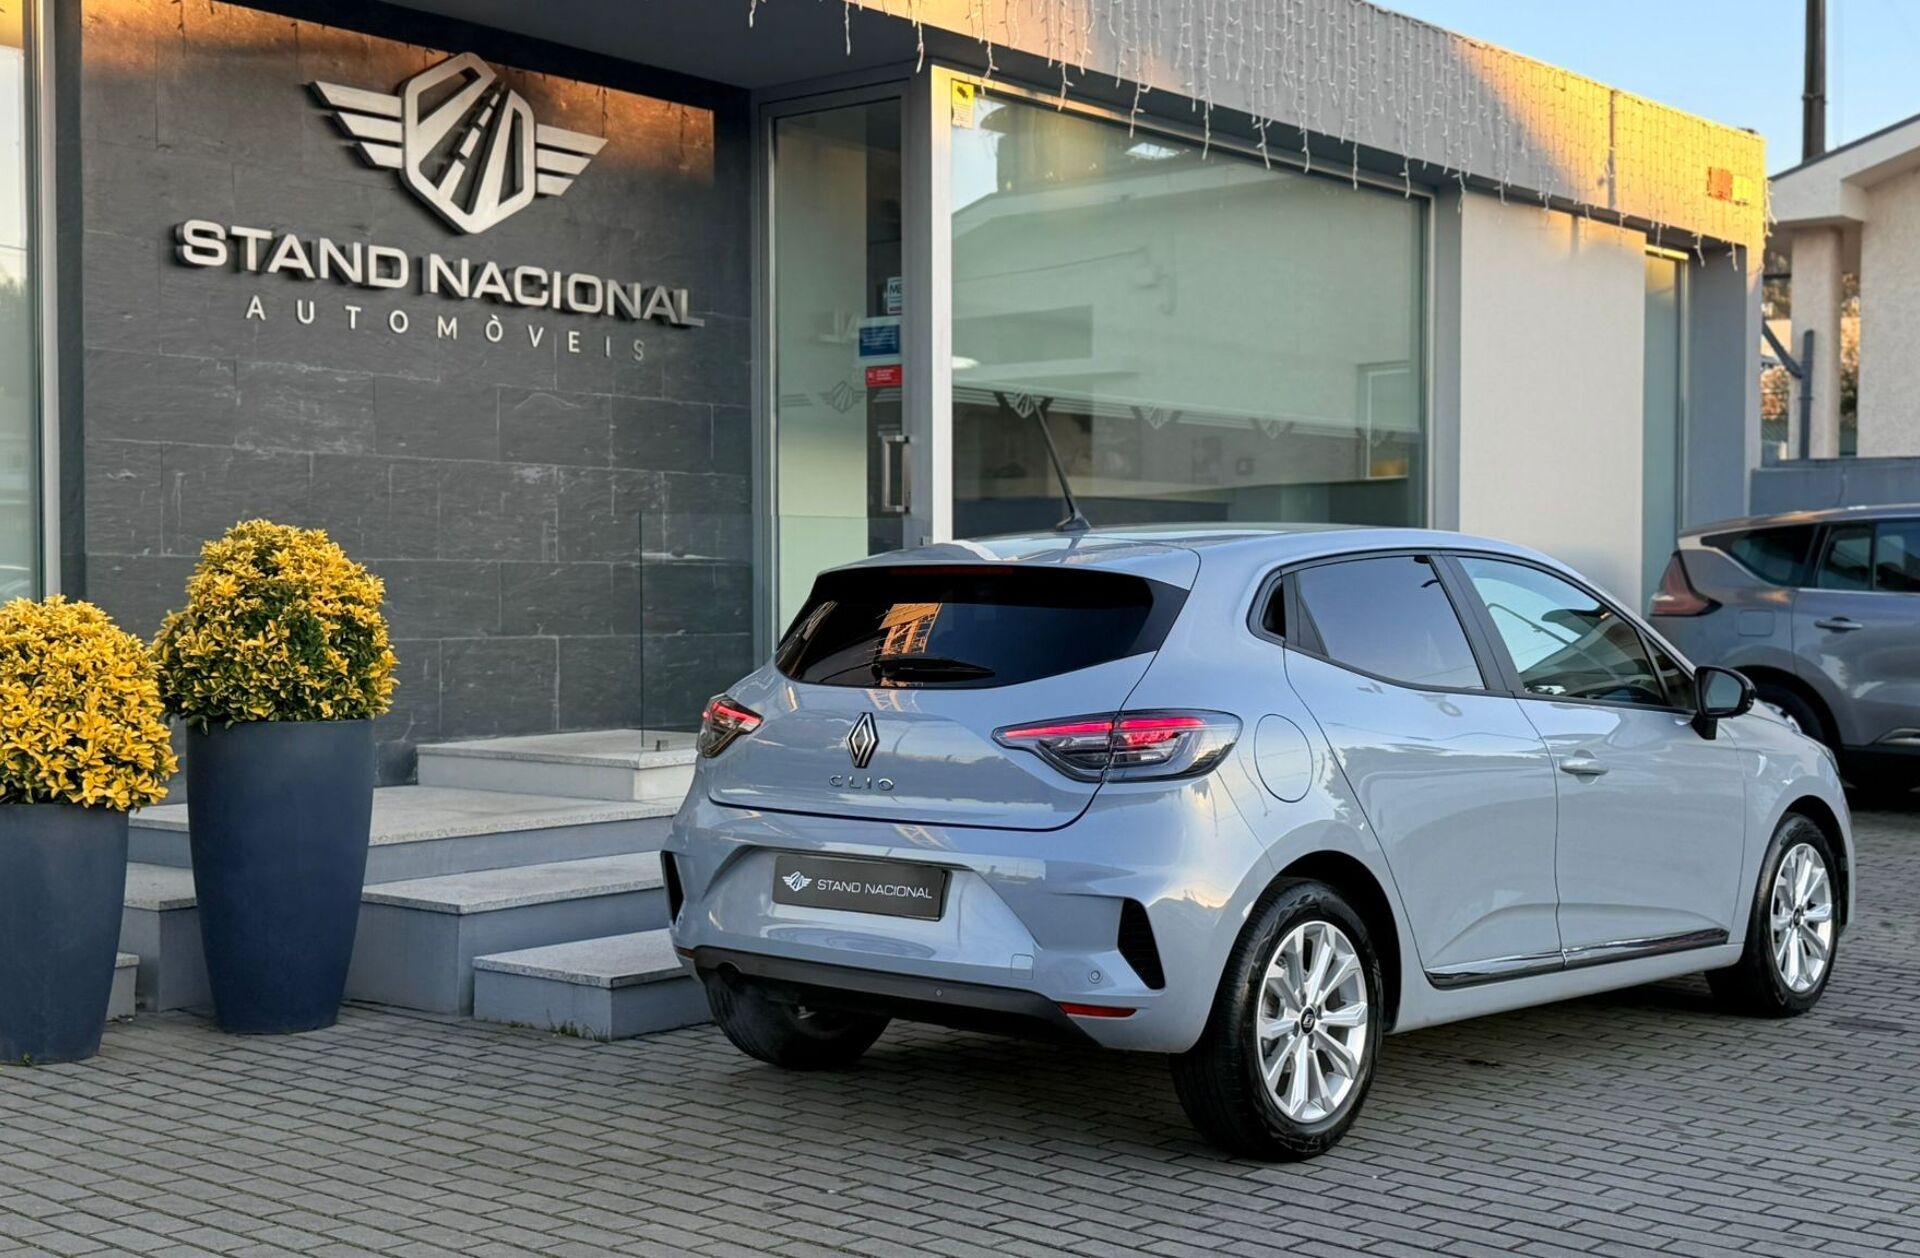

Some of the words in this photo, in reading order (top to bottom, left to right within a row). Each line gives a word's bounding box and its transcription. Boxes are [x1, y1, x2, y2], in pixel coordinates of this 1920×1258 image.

[178, 219, 410, 289] STAND
[421, 253, 705, 328] NACIONAL
[829, 775, 895, 791] CLIO
[817, 879, 861, 893] STAND
[864, 883, 933, 899] NACIONAL
